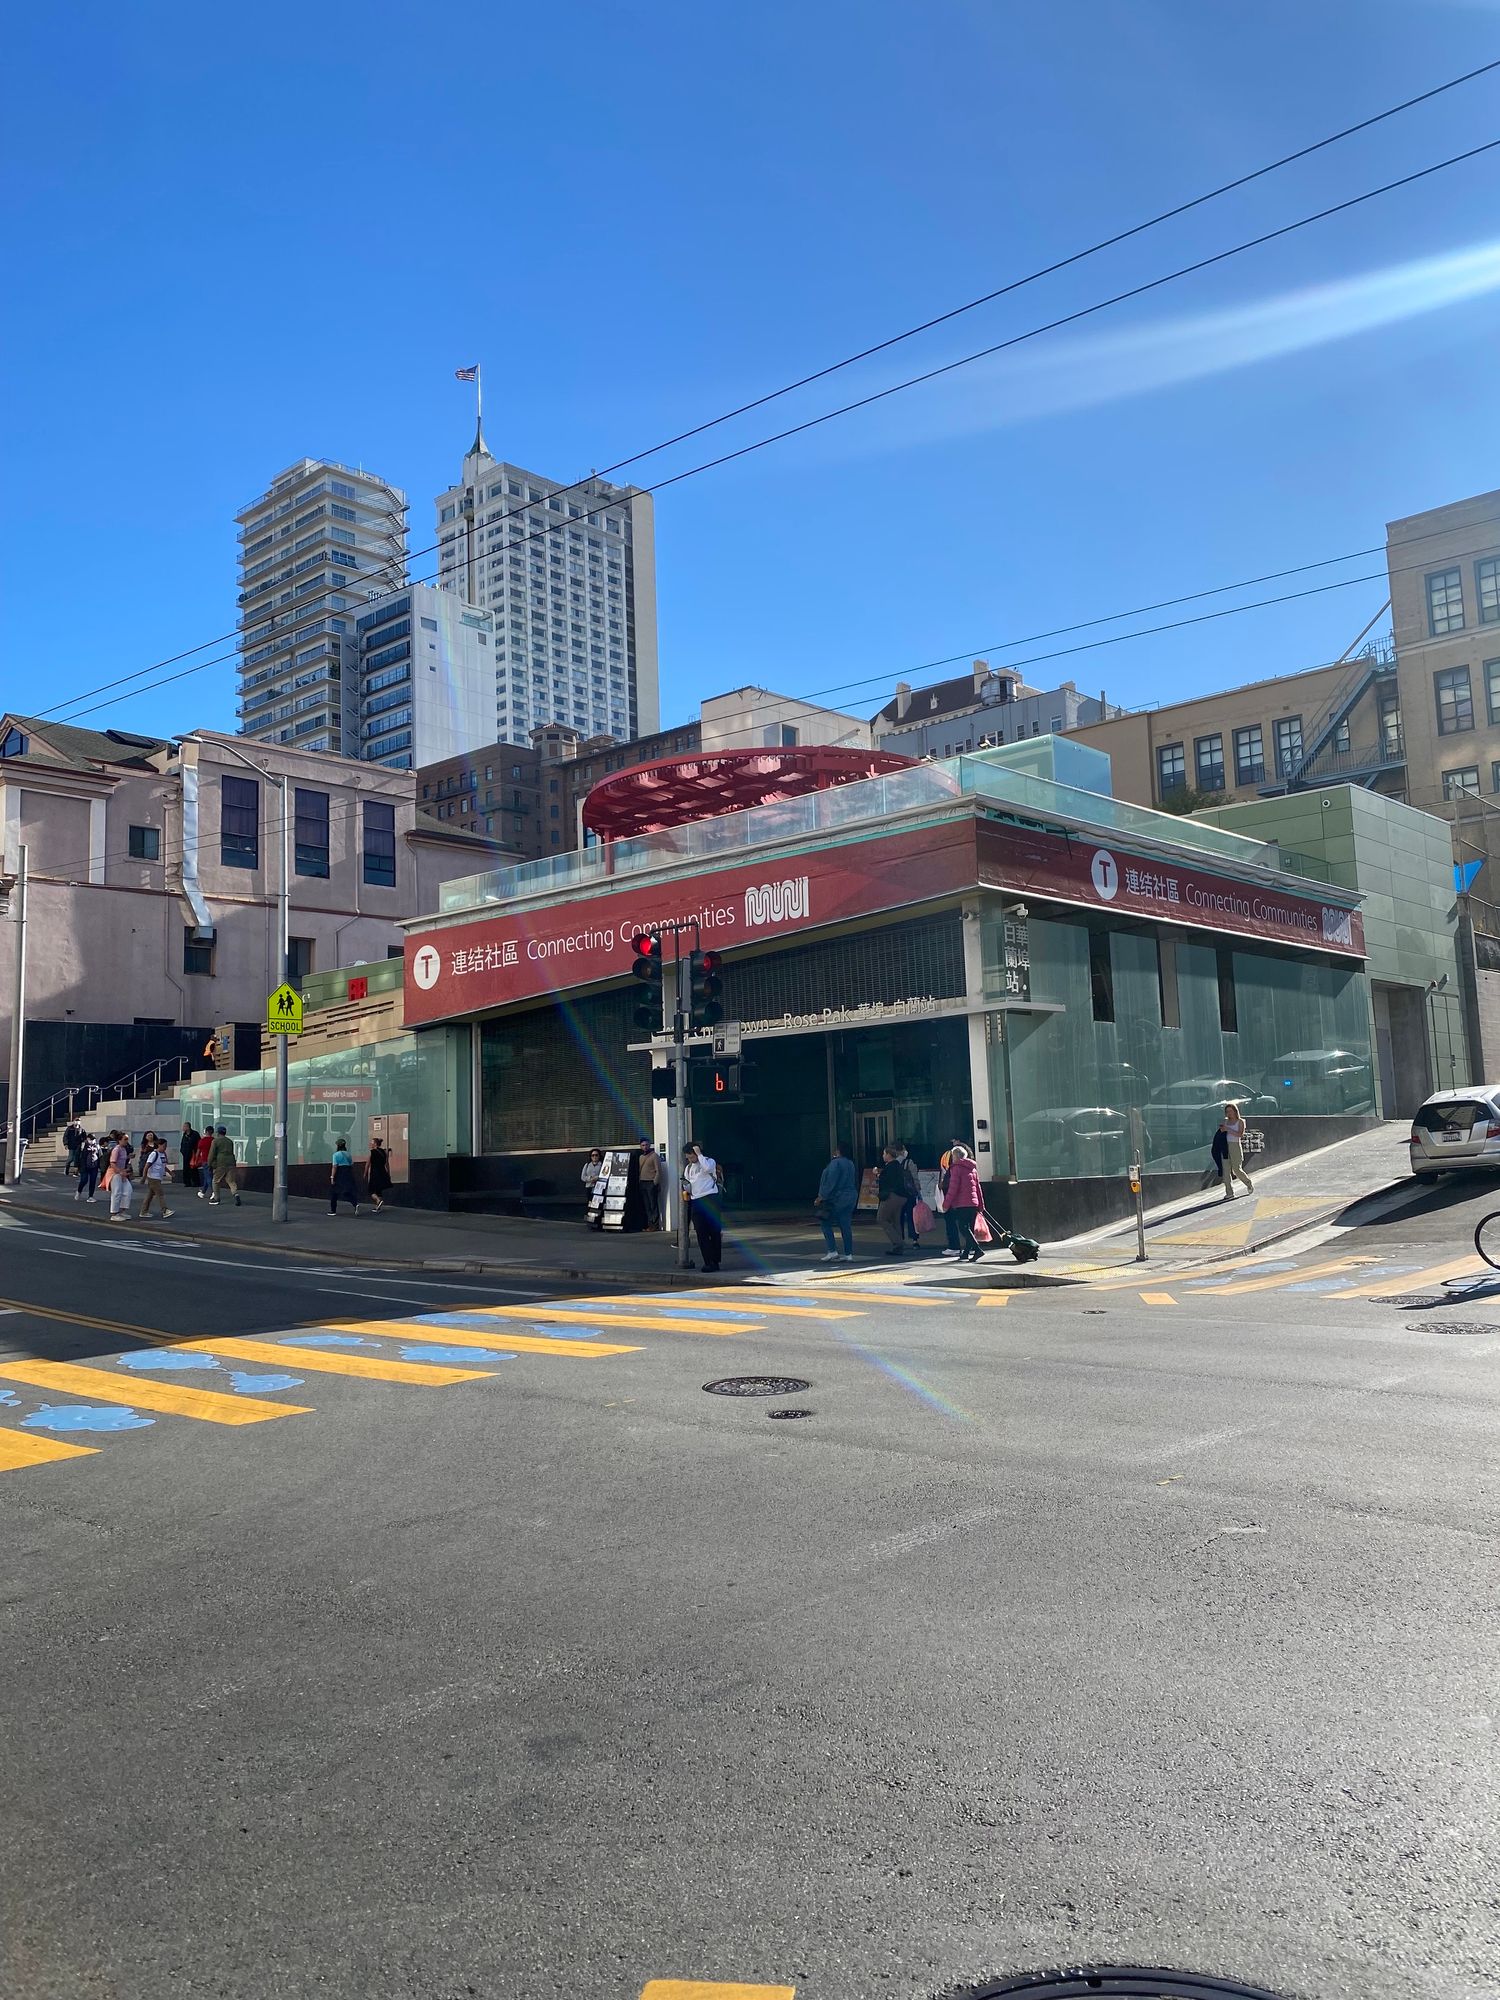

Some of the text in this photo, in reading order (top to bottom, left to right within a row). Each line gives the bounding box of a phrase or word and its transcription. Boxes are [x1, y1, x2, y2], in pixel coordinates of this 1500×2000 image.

[1098, 860, 1110, 888] T
[1185, 883, 1318, 931] Connecting Communities
[527, 904, 735, 960] Connecting Communities
[420, 954, 433, 979] T
[270, 1021, 300, 1031] SCHOOL
[783, 1013, 818, 1029] Rose
[823, 1005, 851, 1024] Pak
